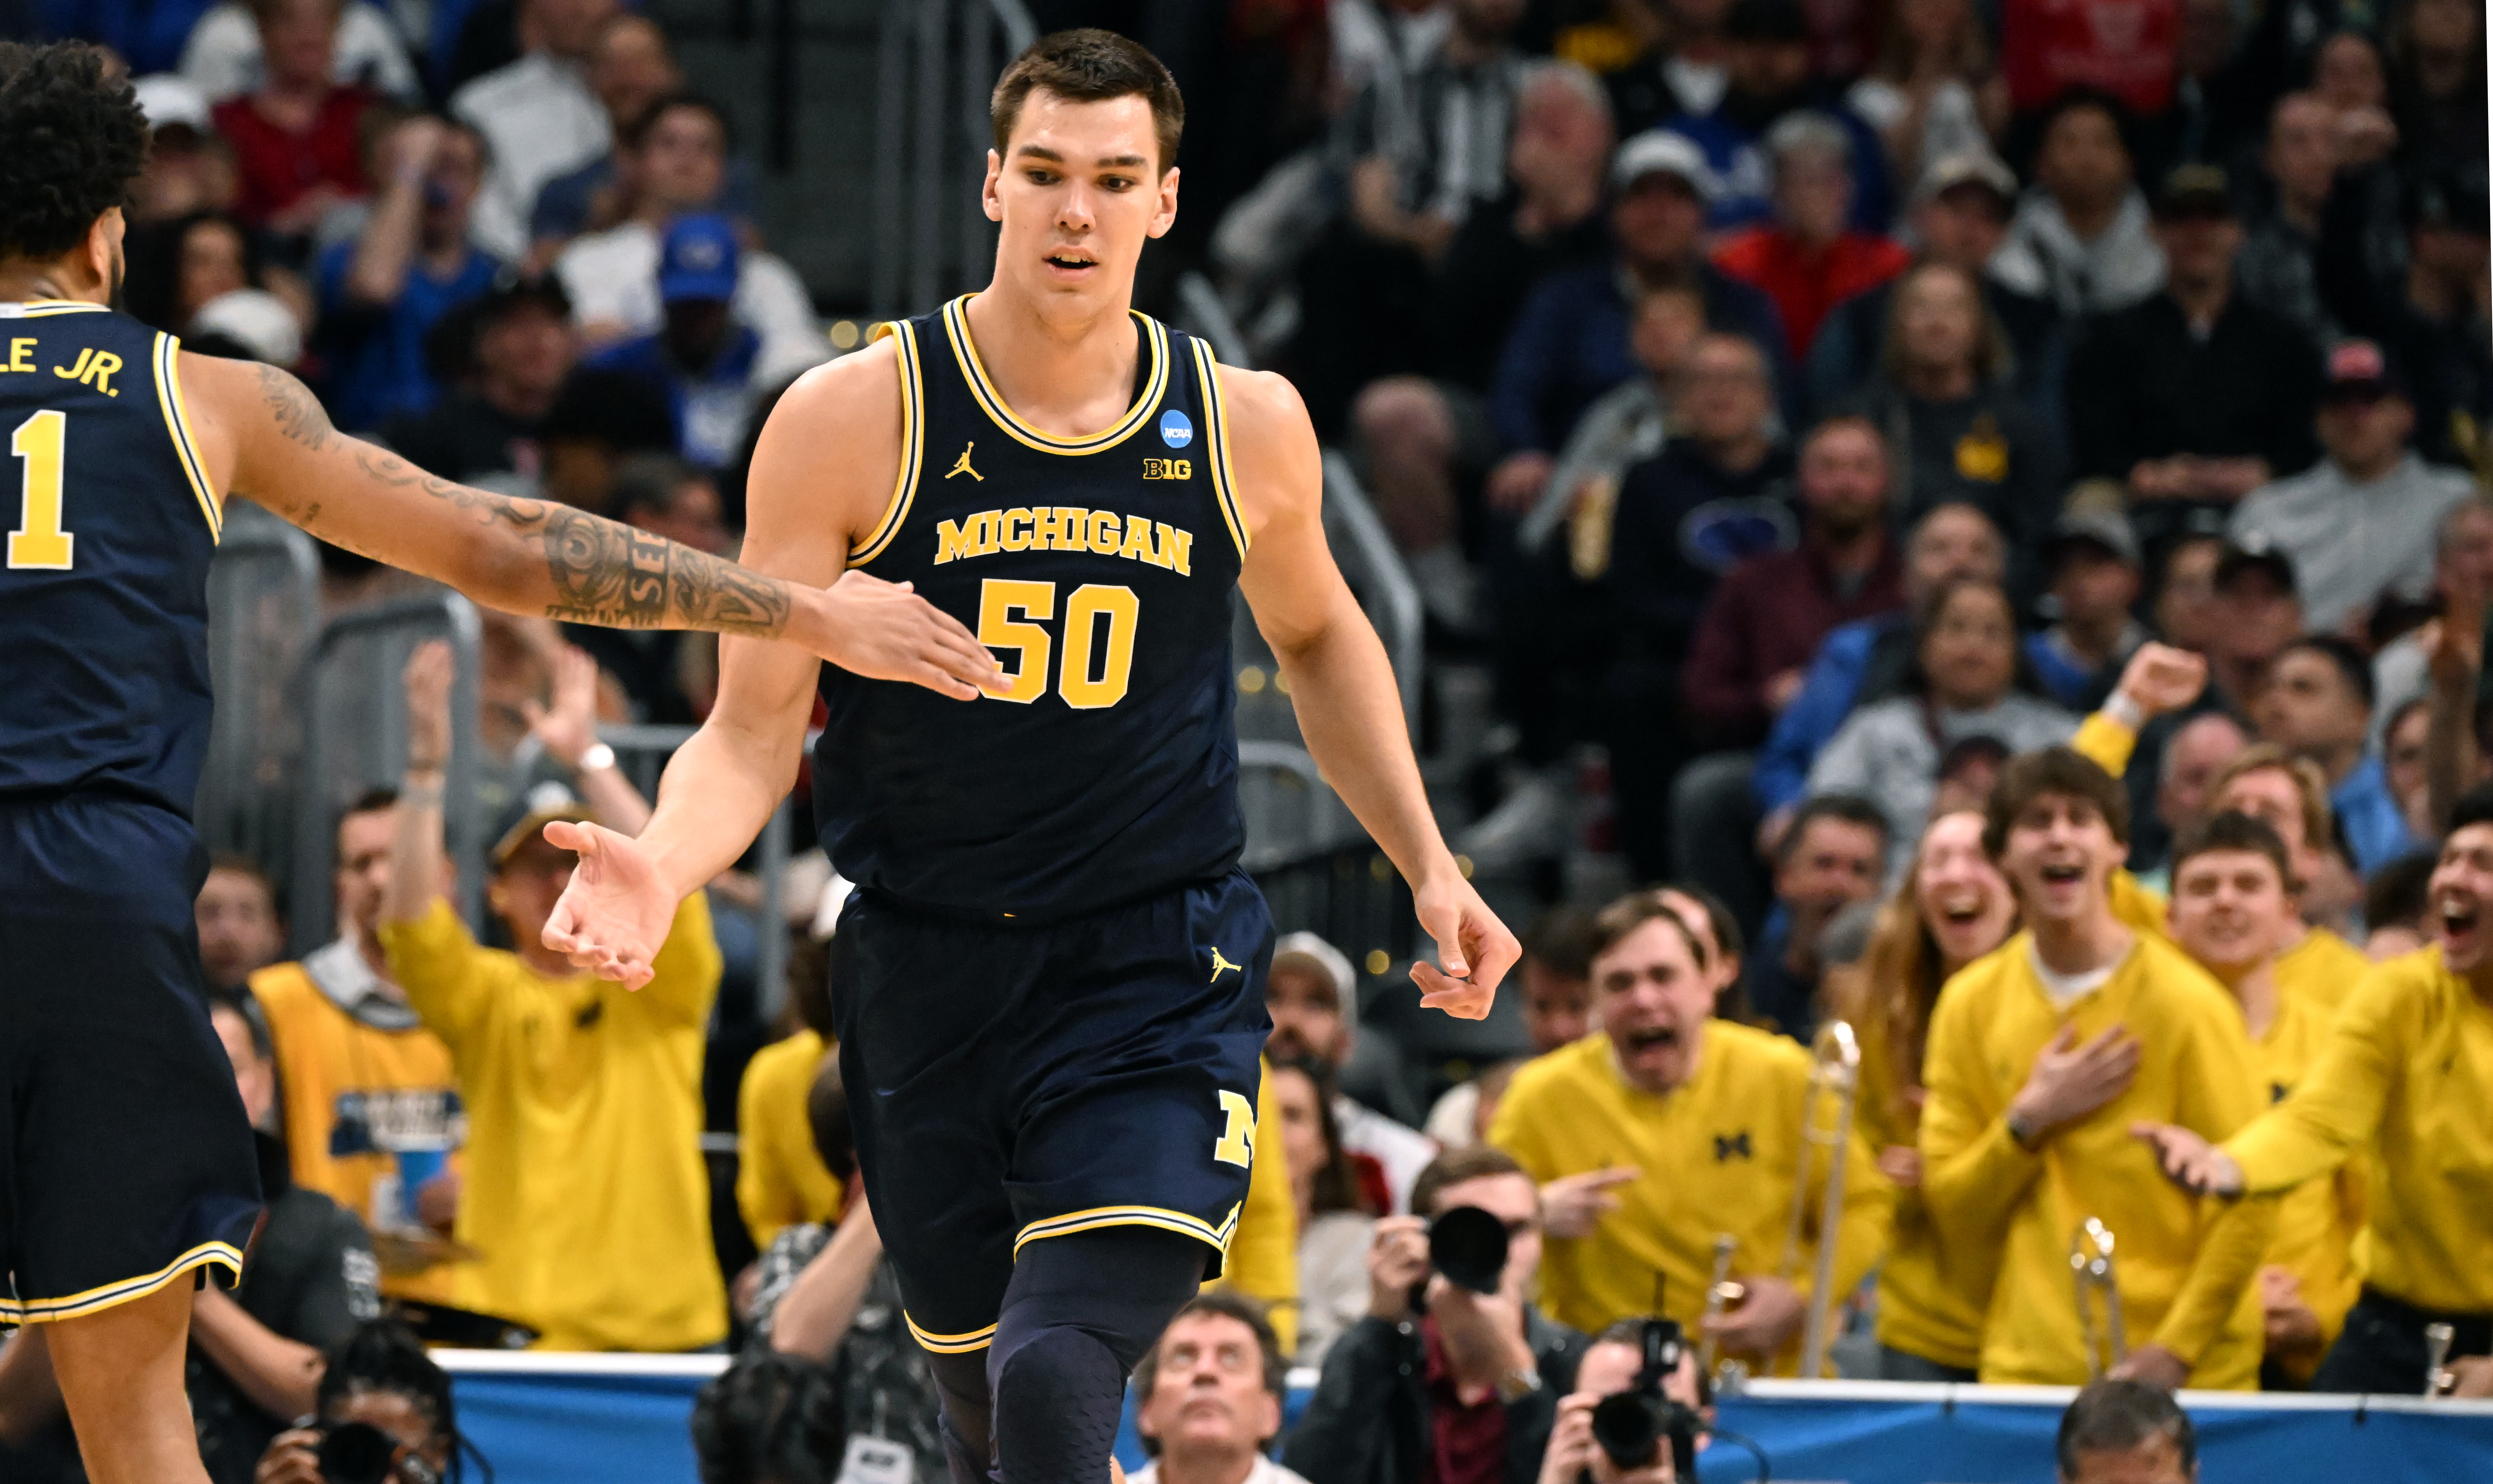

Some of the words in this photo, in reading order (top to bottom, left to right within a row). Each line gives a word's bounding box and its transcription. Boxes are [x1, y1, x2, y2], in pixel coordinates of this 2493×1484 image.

[54, 348, 123, 398] JR.
[1164, 428, 1191, 438] NCAA
[7, 409, 74, 570] 1
[1143, 458, 1192, 480] B1G
[934, 507, 1193, 577] MICHIGAN
[976, 579, 1140, 709] 50
